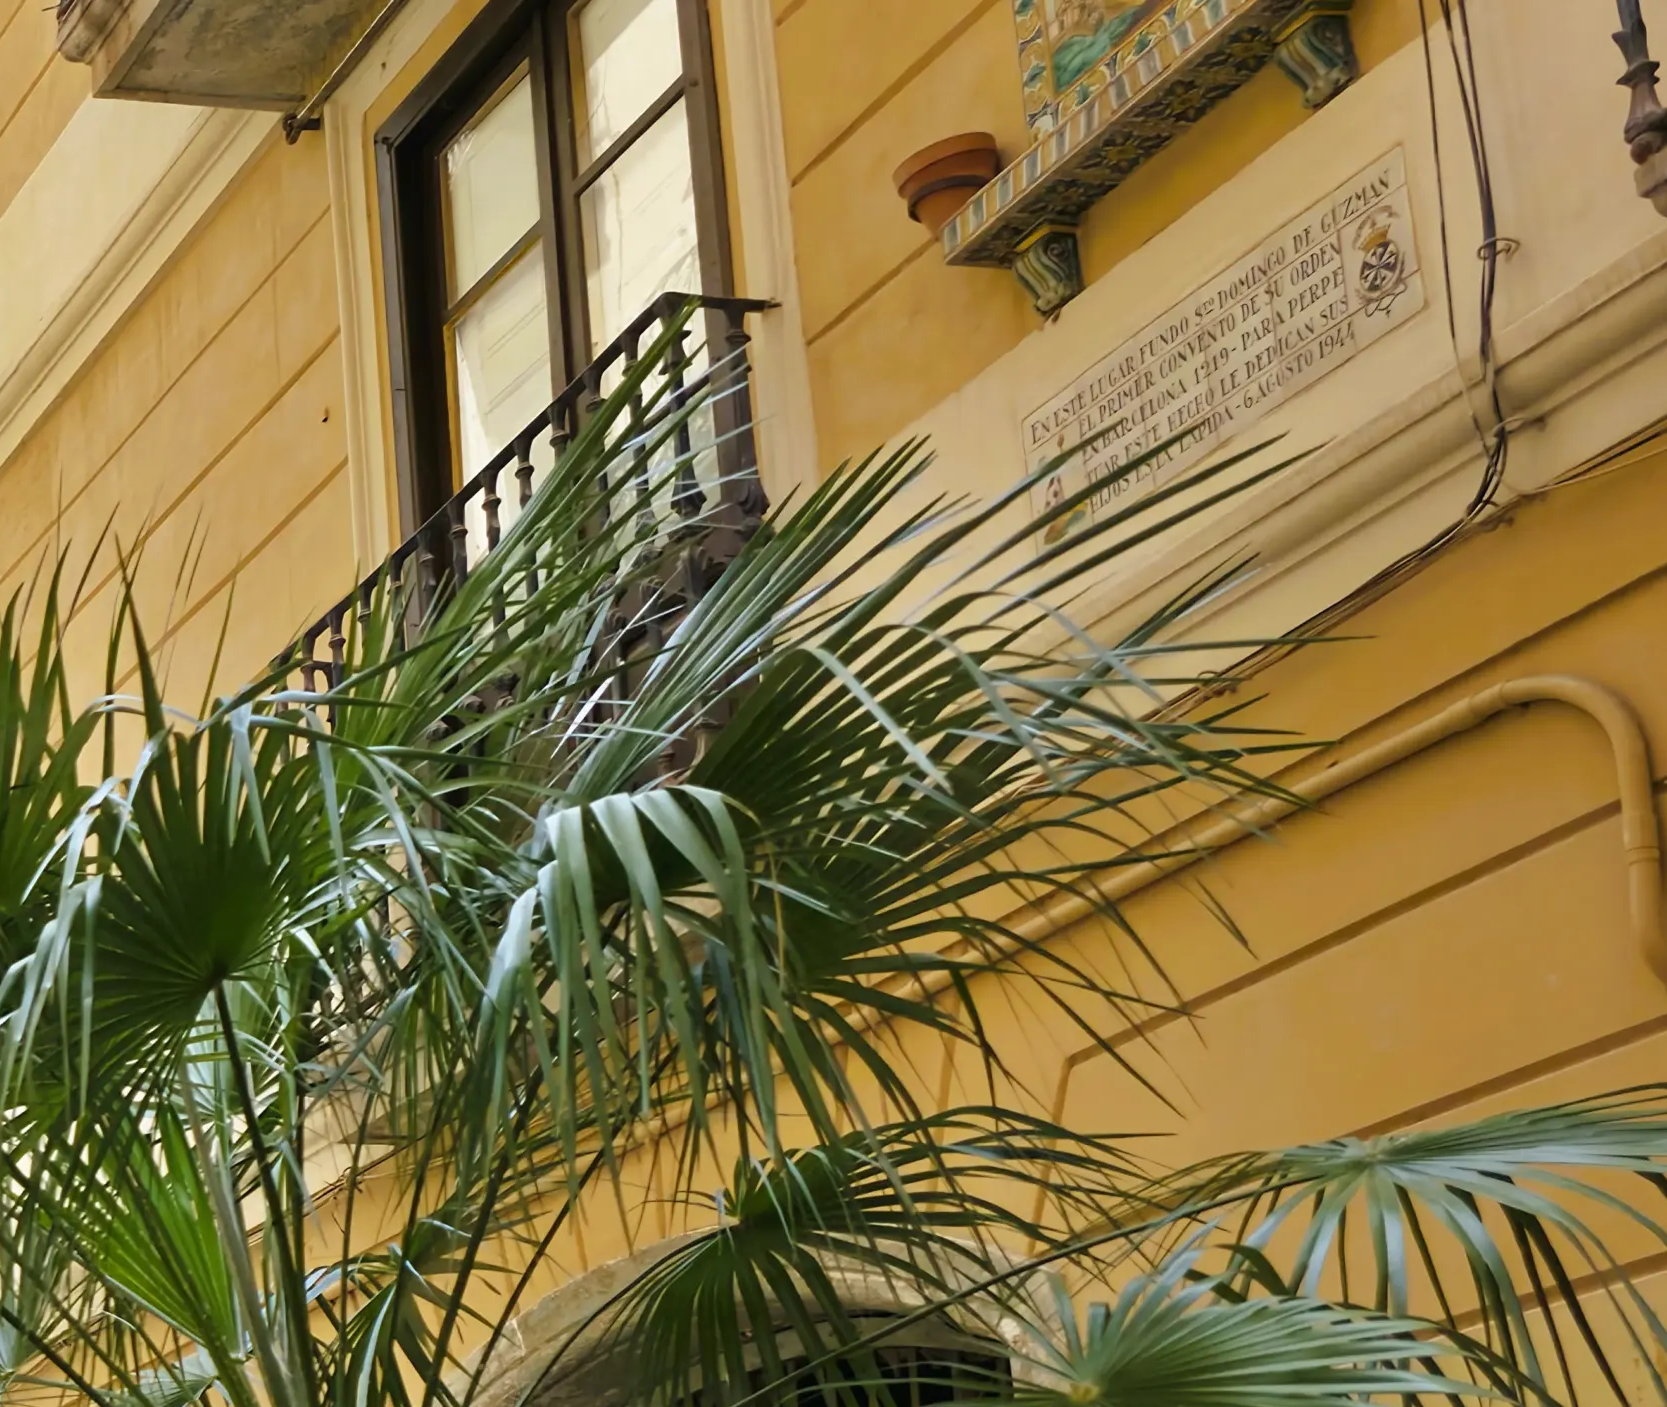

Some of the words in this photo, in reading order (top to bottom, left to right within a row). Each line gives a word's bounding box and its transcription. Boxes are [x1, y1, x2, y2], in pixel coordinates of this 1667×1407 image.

[1030, 416, 1050, 445] EN
[1054, 390, 1086, 428] ESTE
[1089, 356, 1136, 402] LUGAR
[1139, 316, 1189, 365] FUNDO
[1217, 246, 1286, 310] DOMINGO
[1292, 225, 1315, 254] DE
[1320, 168, 1391, 233] GUZMAN
[1078, 416, 1096, 440] EL
[1099, 371, 1156, 424] PRIMER
[1159, 312, 1236, 379] CONVENTO
[1241, 294, 1261, 323] DE
[1264, 275, 1284, 305] SU
[1290, 240, 1341, 287] ORDEN
[1101, 378, 1188, 451] BARCELONA
[1241, 311, 1286, 351] PARA
[1287, 266, 1345, 319] PERPE
[1124, 423, 1162, 462] ESTE
[1167, 388, 1215, 433] HECHO
[1220, 369, 1241, 398] LE
[1244, 317, 1315, 380] DEDICAN
[1319, 295, 1349, 327] SUS
[1318, 320, 1356, 360] 1944
